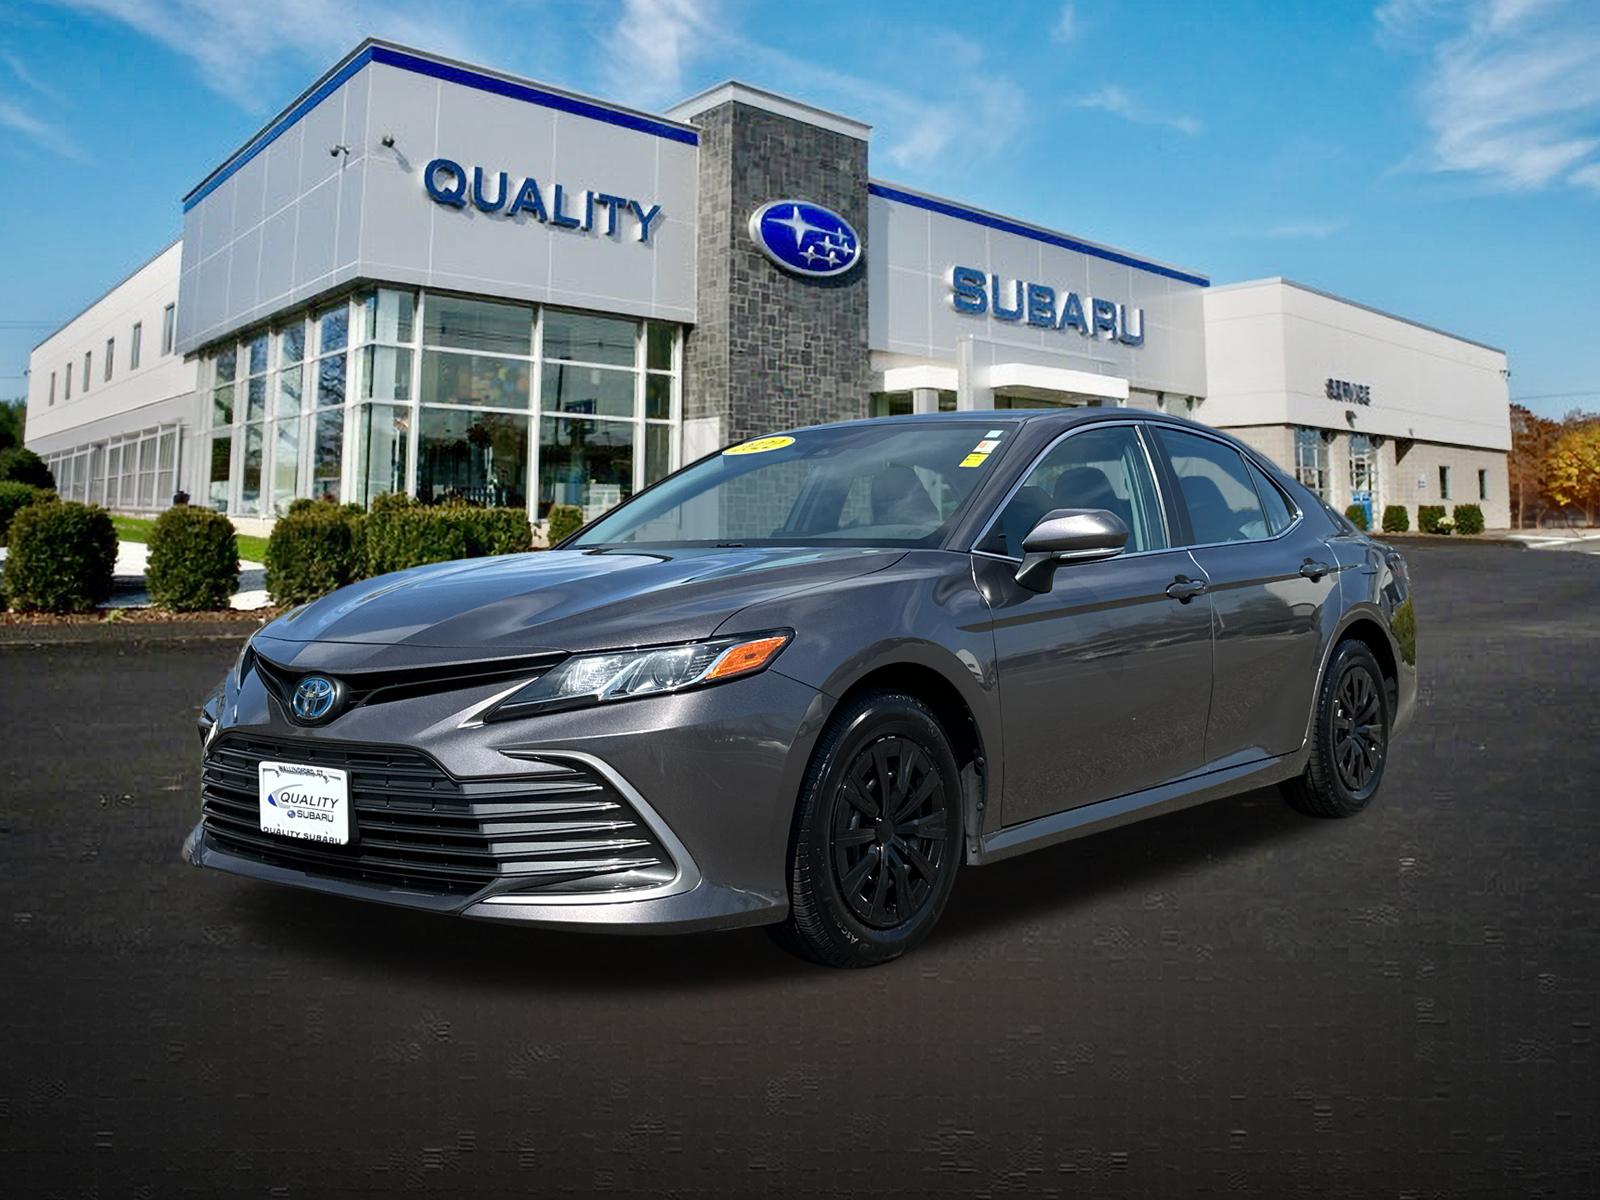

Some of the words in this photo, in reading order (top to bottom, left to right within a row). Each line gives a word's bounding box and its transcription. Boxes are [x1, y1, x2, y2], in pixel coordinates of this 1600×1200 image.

[424, 158, 661, 243] QUALITY
[949, 265, 1145, 347] SUBARU
[1325, 378, 1371, 407] SERVICE
[280, 791, 339, 809] QUALITY
[296, 810, 334, 822] SUBARU
[262, 826, 301, 839] QUALITY
[303, 832, 342, 845] SUBARU
